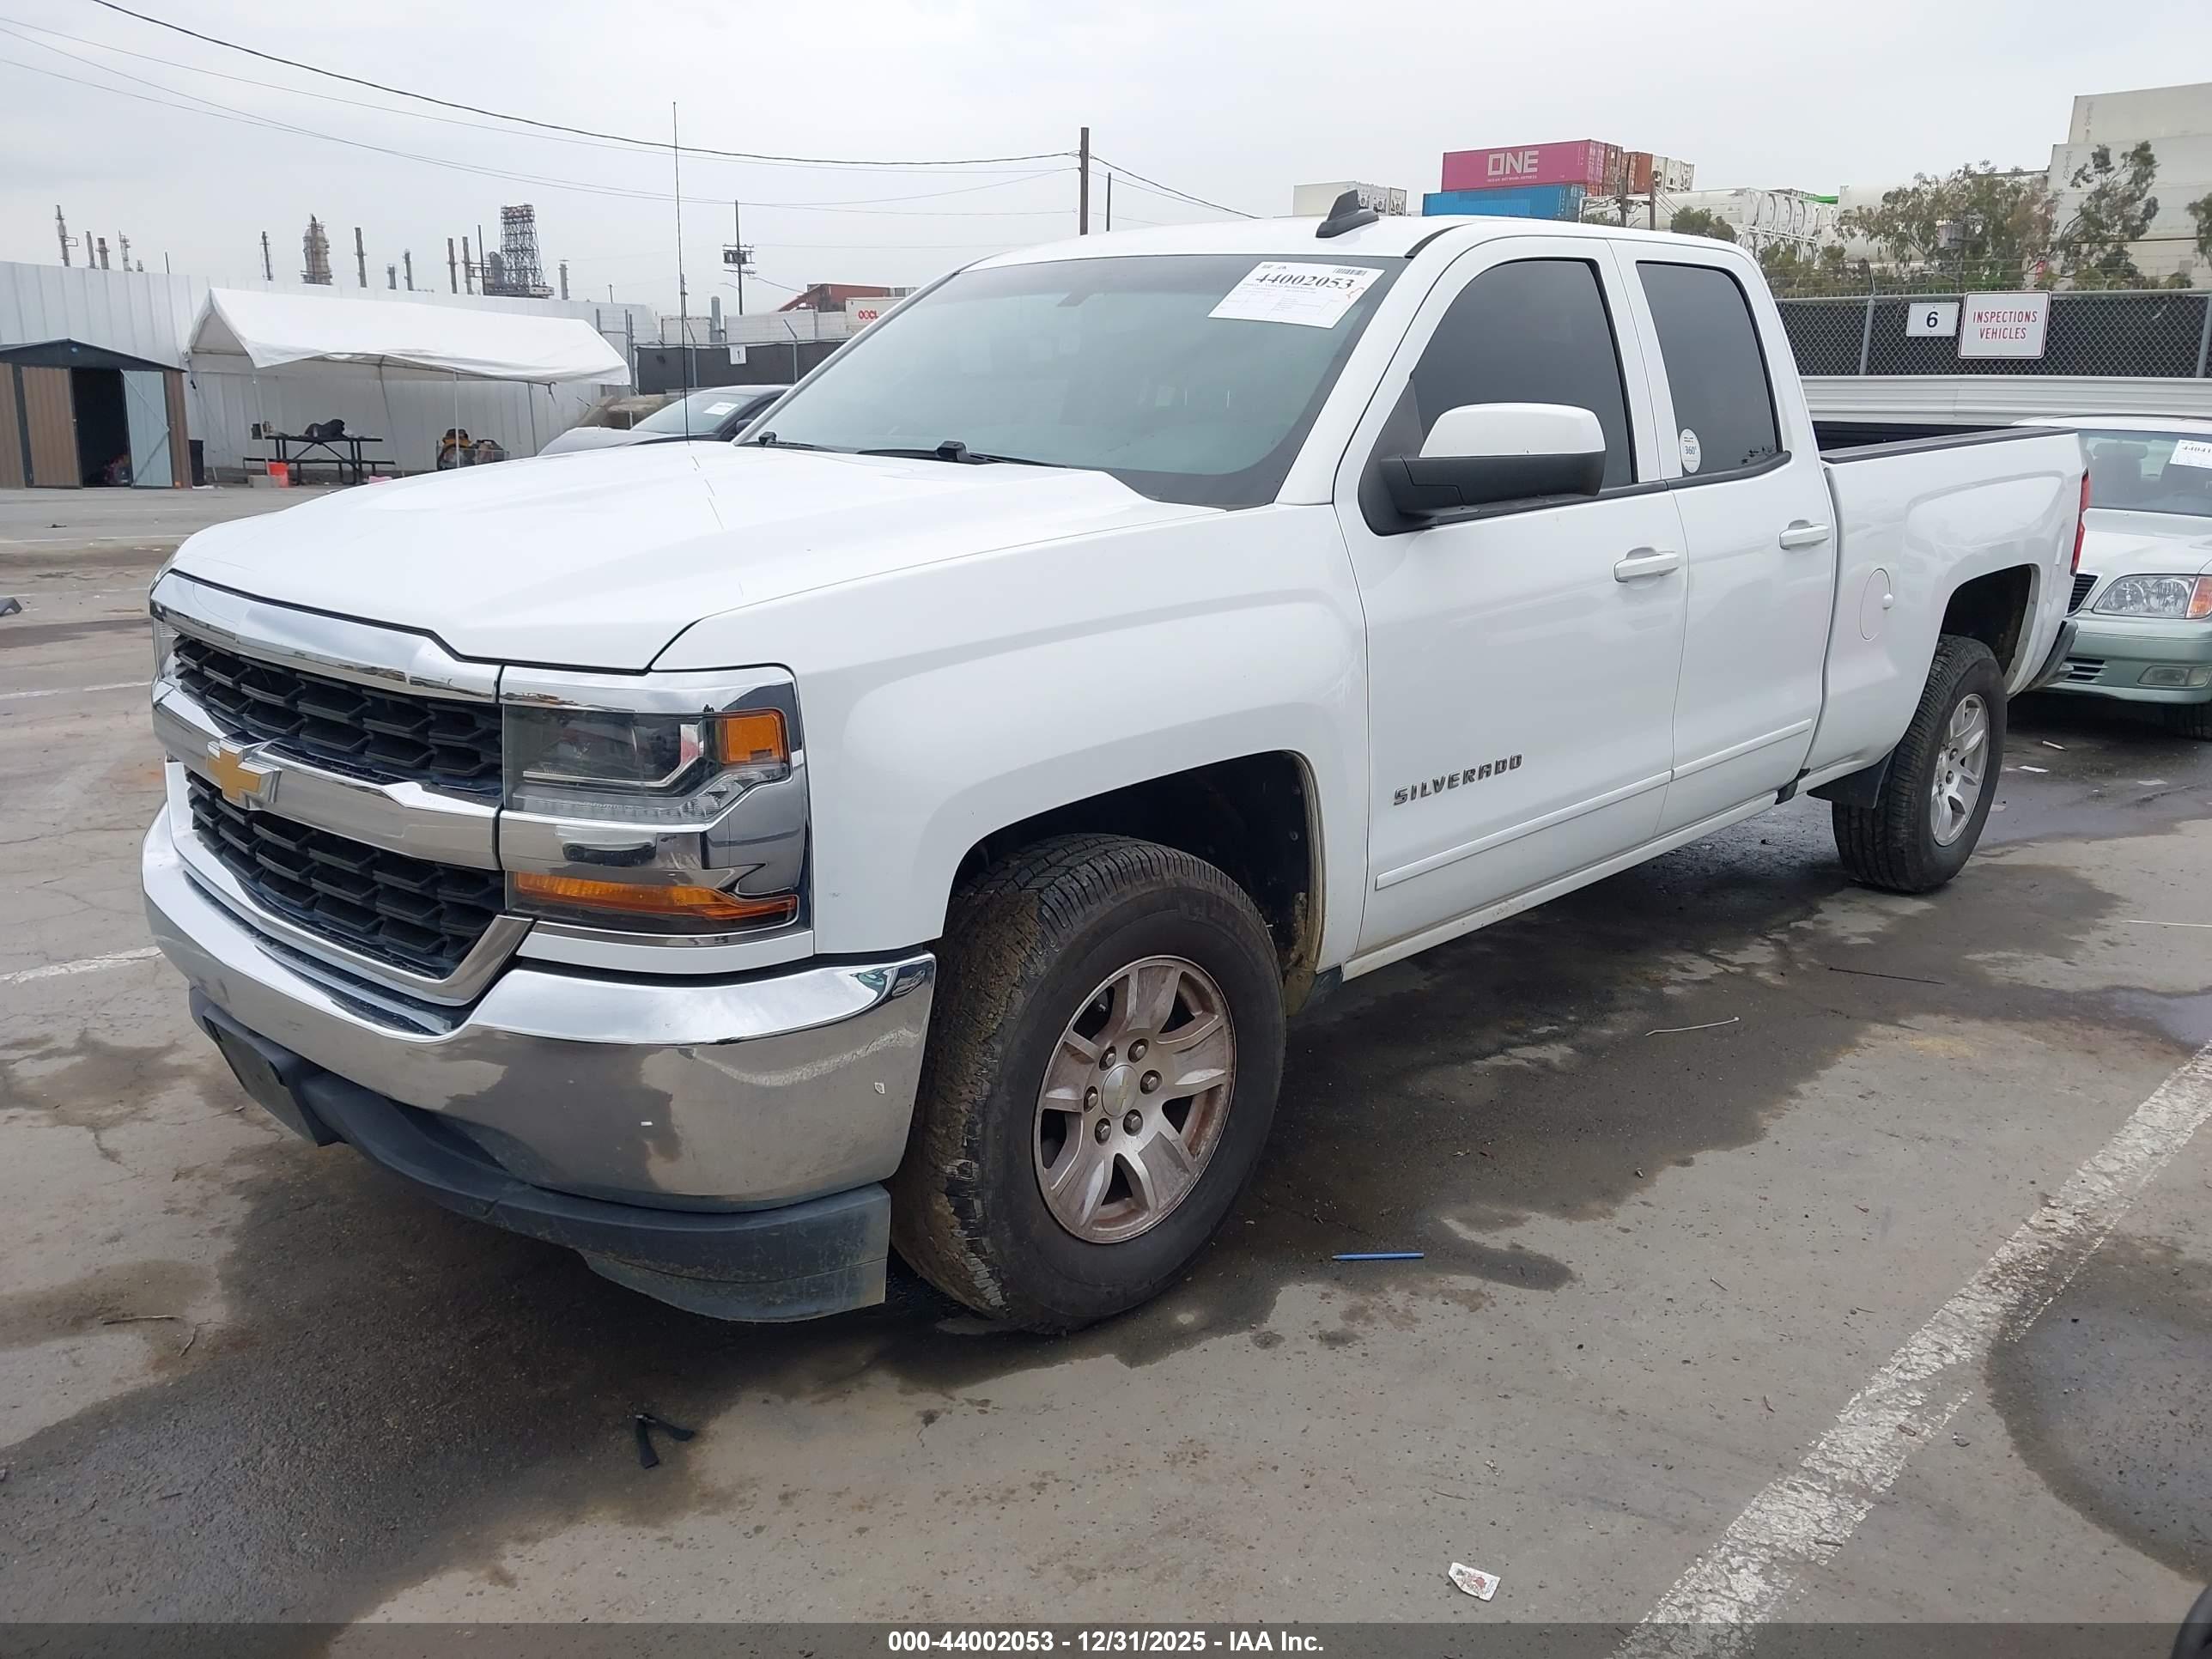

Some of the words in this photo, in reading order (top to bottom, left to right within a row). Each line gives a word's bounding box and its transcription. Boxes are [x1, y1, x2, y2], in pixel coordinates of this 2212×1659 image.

[1487, 149, 1540, 176] ONE
[1255, 272, 1356, 290] 44002053
[858, 309, 879, 320] OOCL
[1925, 311, 1939, 328] 6
[1972, 310, 2039, 324] INSPECTIONS
[1978, 326, 2027, 340] VEHICLES
[1393, 753, 1523, 806] SILVERADO
